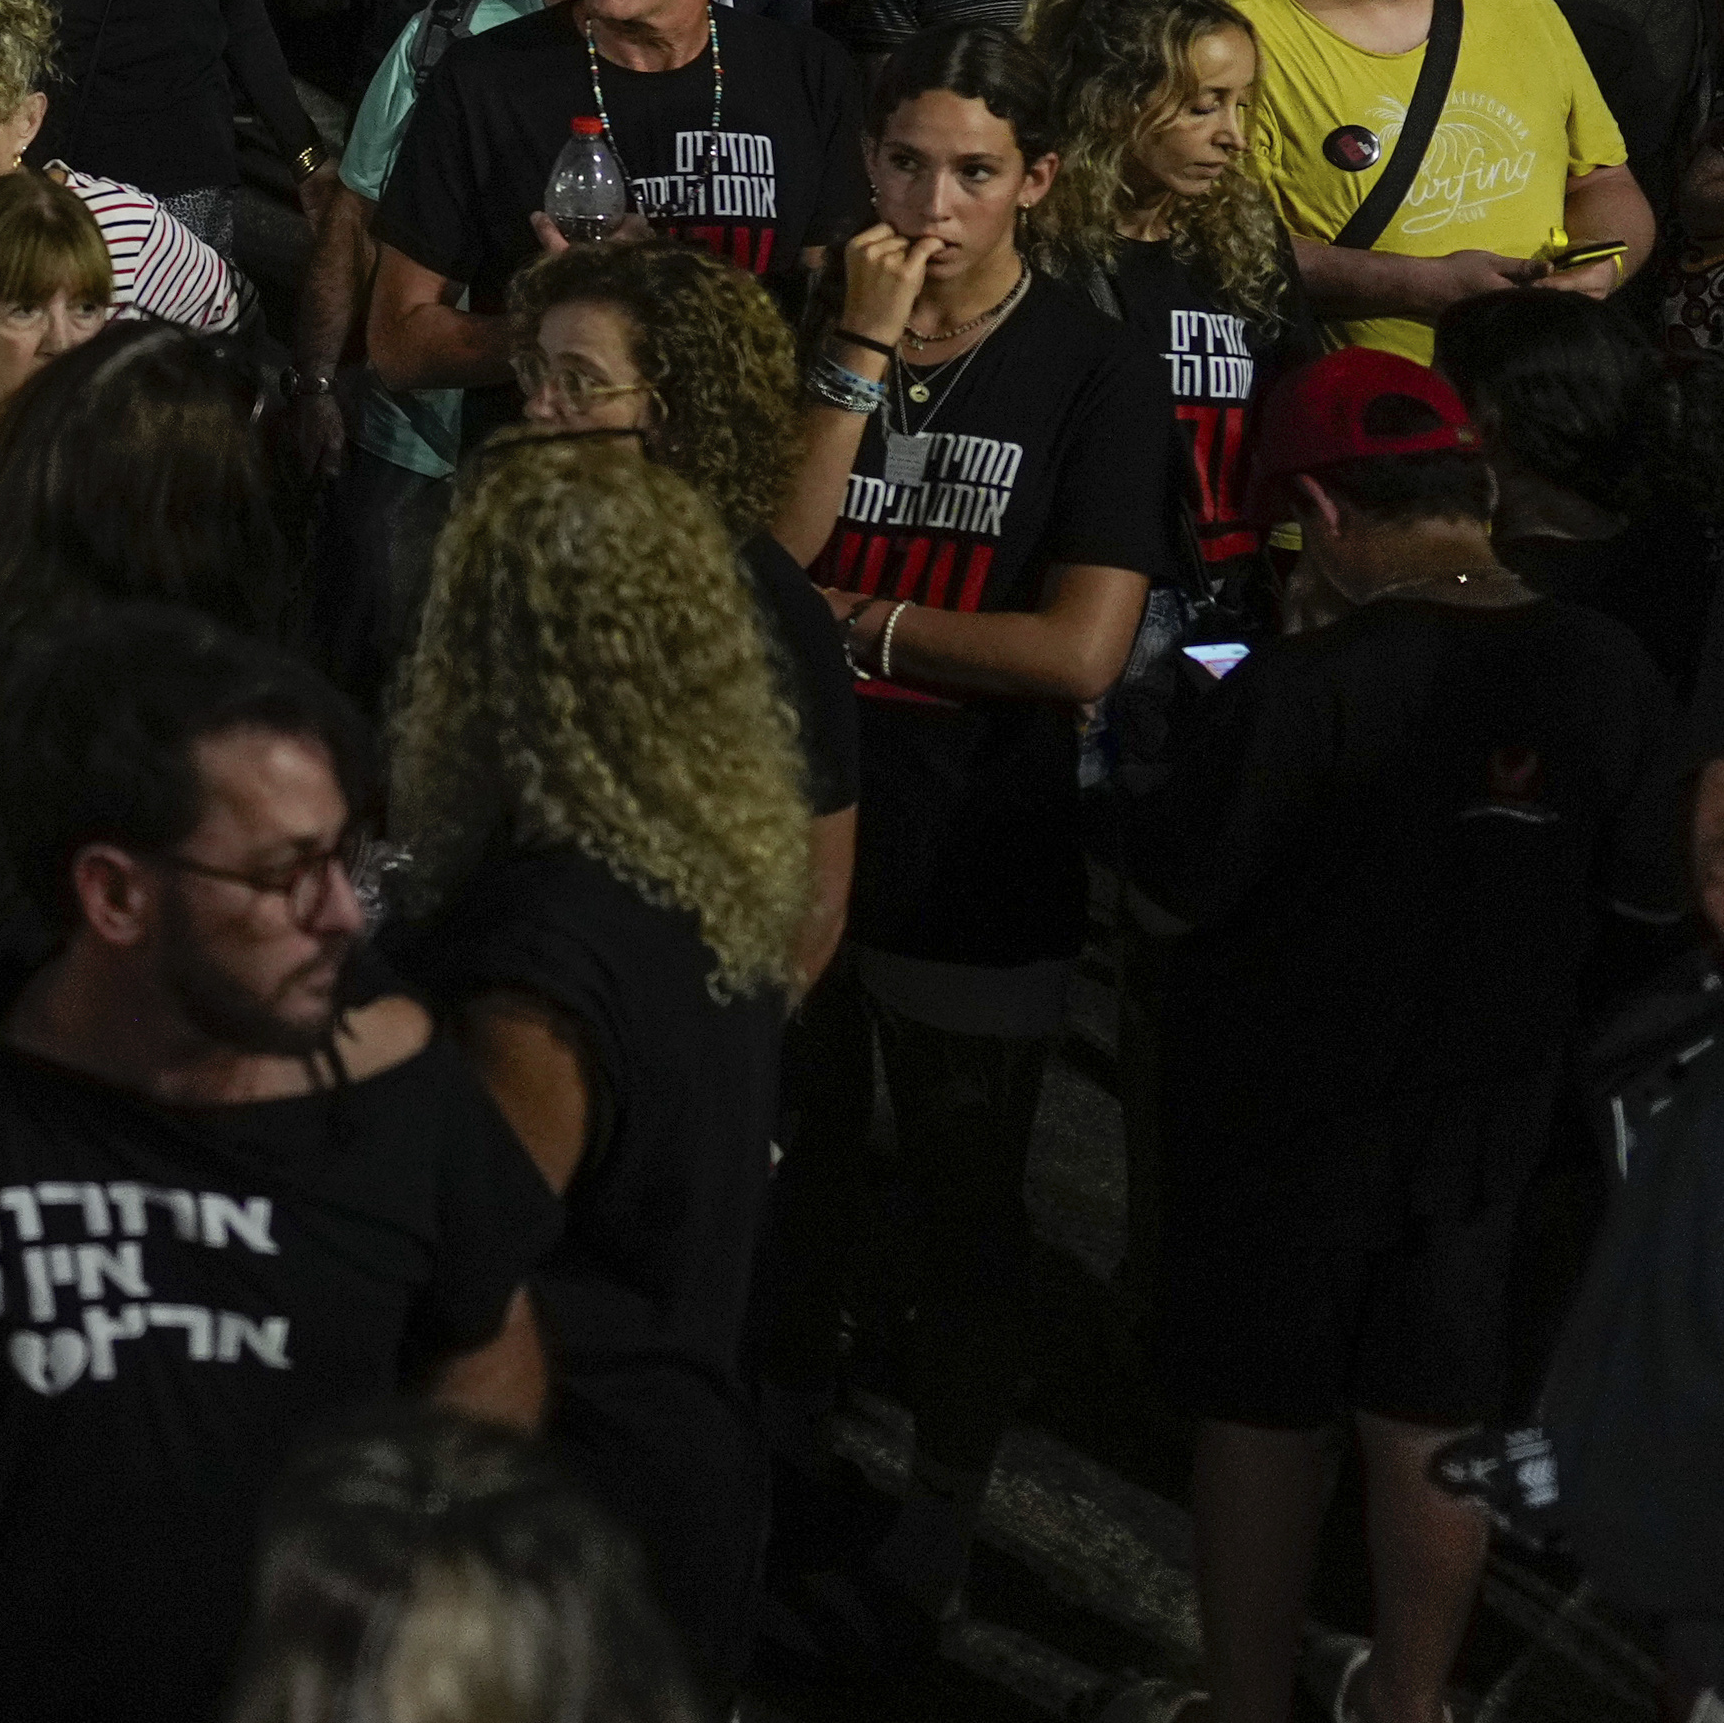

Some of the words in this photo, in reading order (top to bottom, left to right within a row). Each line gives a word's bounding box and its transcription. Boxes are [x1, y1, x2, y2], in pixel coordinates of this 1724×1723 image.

[1446, 90, 1530, 141] ALIFORNIA
[675, 129, 775, 176] מחזירים
[712, 174, 778, 219] אותם
[1402, 146, 1536, 234] urfing
[80, 1301, 295, 1382] ארץ
